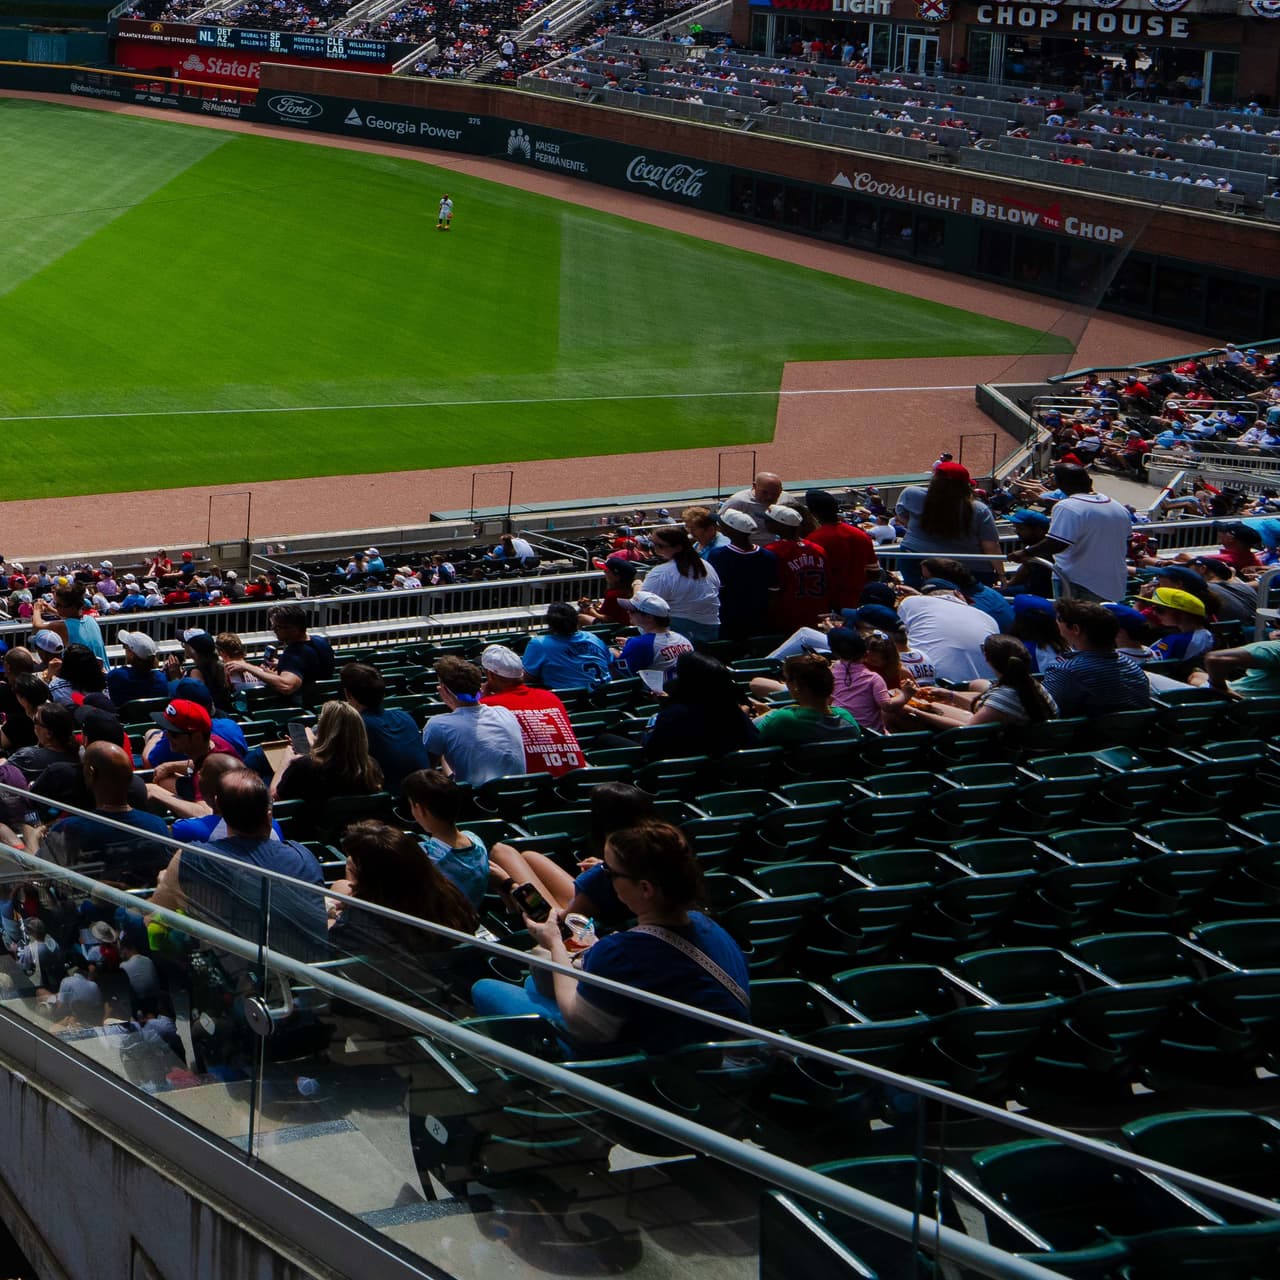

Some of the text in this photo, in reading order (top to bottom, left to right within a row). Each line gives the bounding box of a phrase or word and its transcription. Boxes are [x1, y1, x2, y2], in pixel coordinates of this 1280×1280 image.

[977, 4, 1189, 39] CHOP HOUSE
[200, 31, 214, 42] NL
[327, 38, 343, 46] CLE
[277, 97, 313, 118] Ford
[366, 115, 462, 139] Georgia Power
[468, 117, 480, 125] 375
[535, 141, 559, 154] KAISER
[535, 151, 585, 172] PERMANENTE
[853, 172, 960, 211] Coors LIGHT
[972, 198, 1124, 243] BELOW THE CHOP
[542, 753, 578, 766] 10-0
